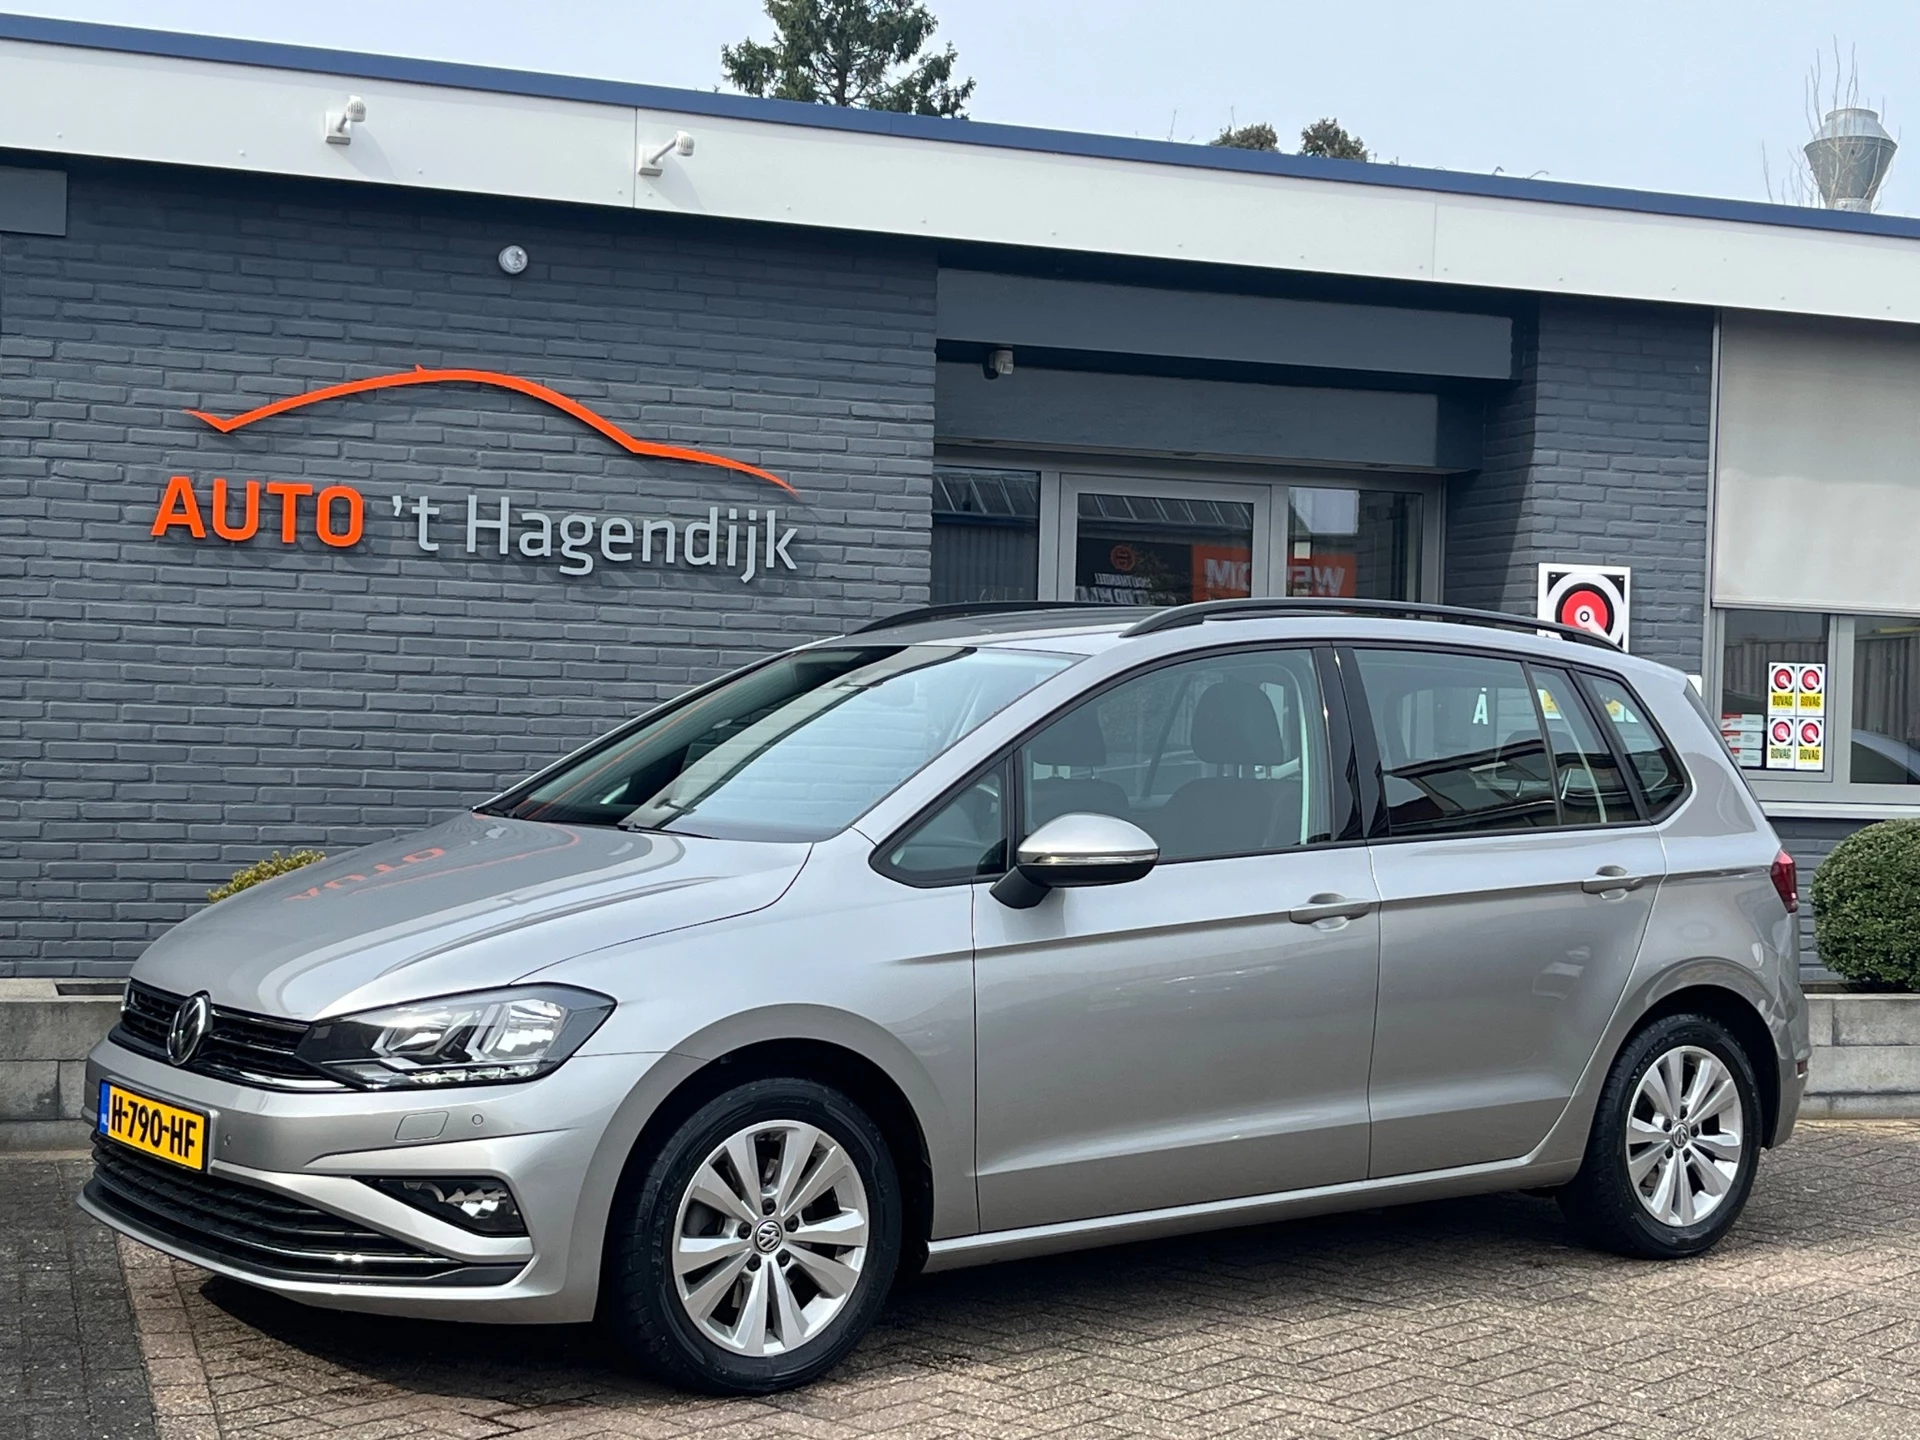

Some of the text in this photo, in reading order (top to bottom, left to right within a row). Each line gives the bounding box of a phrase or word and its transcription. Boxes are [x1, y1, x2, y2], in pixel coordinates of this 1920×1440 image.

[150, 475, 364, 547] AUTO
[466, 494, 798, 584] Hagendijk
[1772, 694, 1793, 707] BOVAG
[1800, 695, 1821, 708] BOVAG
[1770, 747, 1791, 759] BOVAG
[1799, 748, 1820, 760] BOVAG
[111, 1093, 198, 1159] H-790-HF
